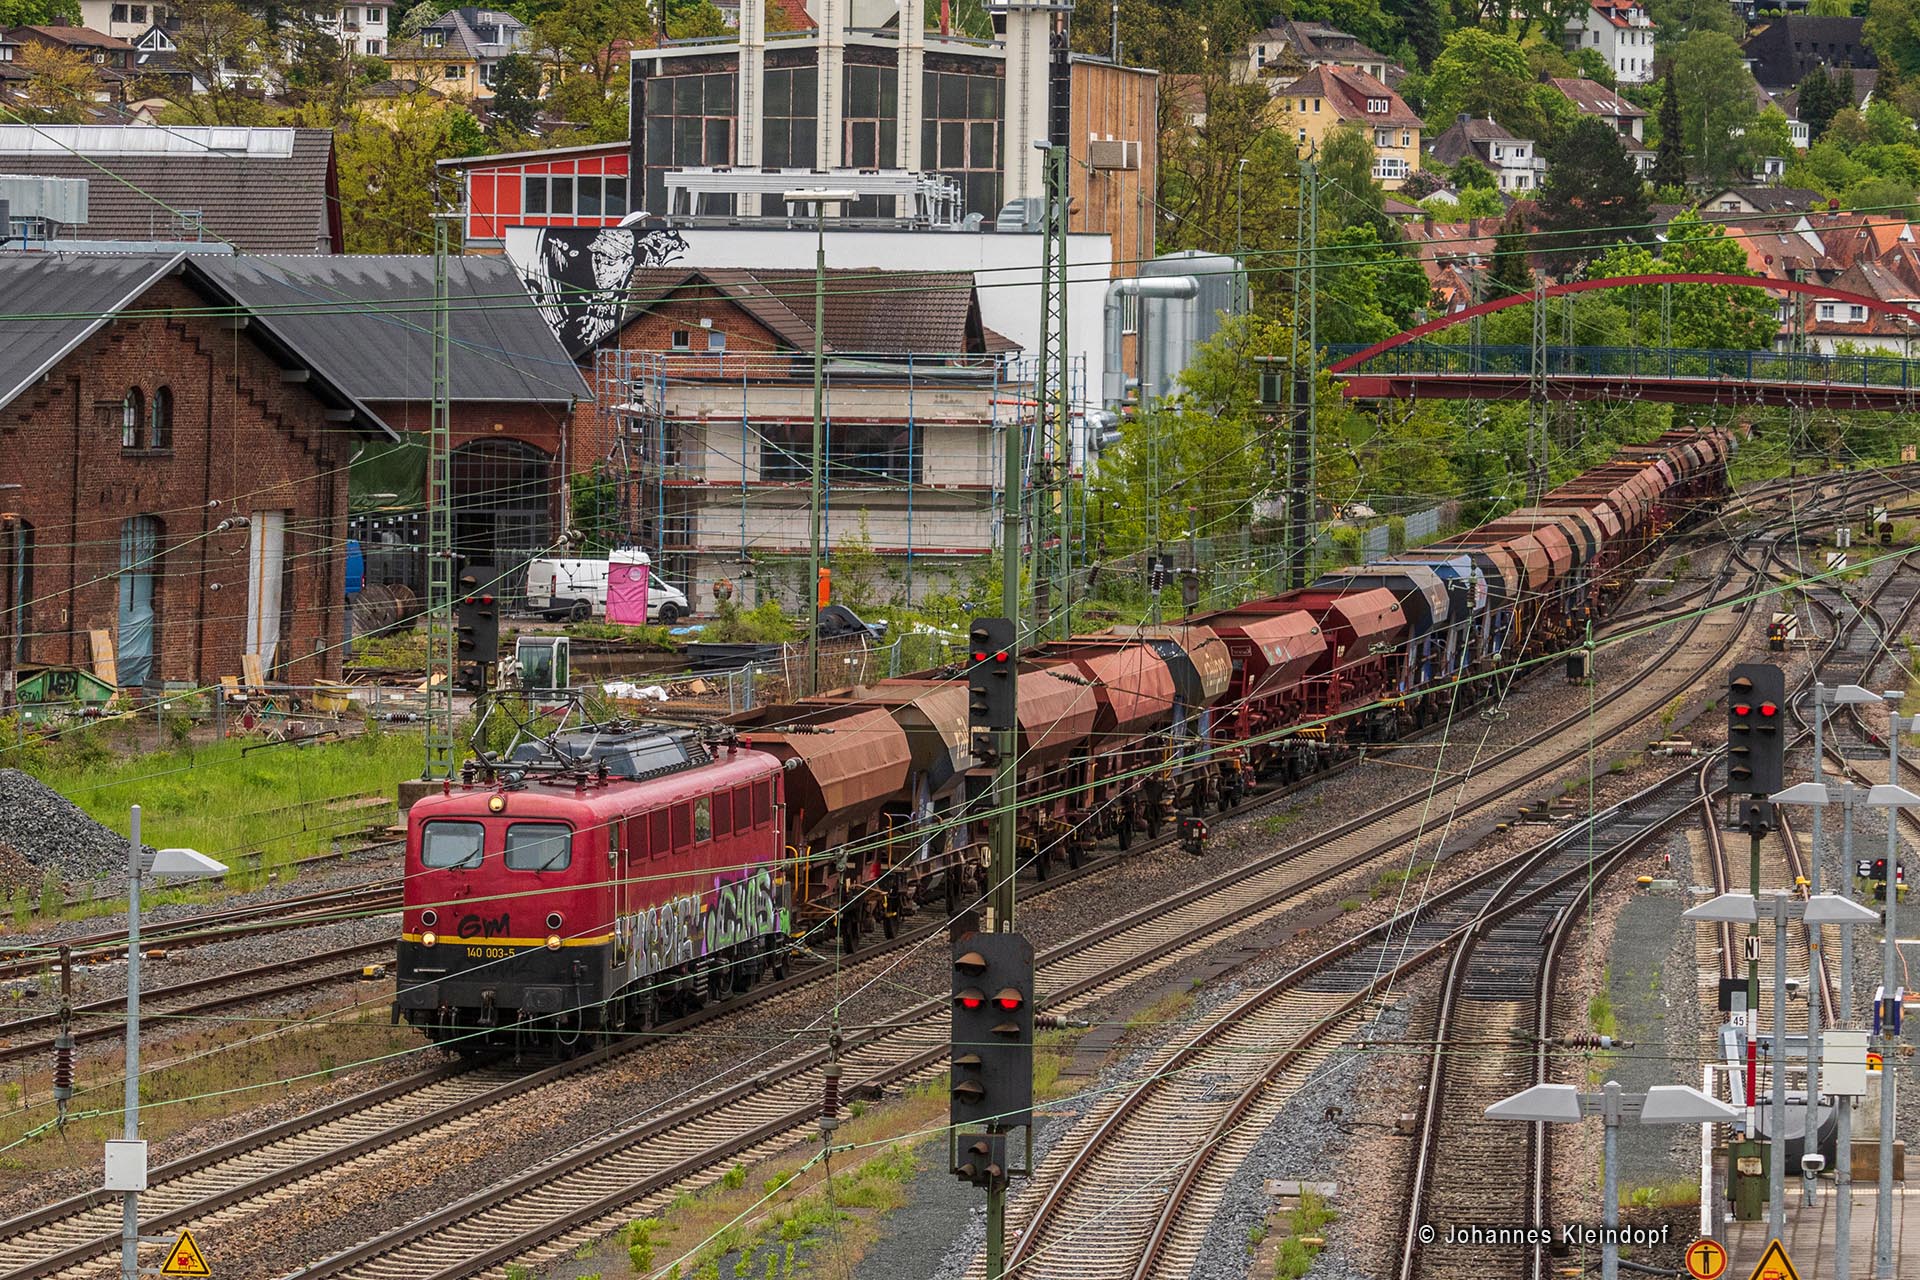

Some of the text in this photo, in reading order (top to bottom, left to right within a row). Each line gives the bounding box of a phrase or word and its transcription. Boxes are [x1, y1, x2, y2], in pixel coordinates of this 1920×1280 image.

[466, 947, 516, 959] 140 003-5
[1744, 938, 1760, 958] N1
[1733, 1016, 1744, 1026] 45
